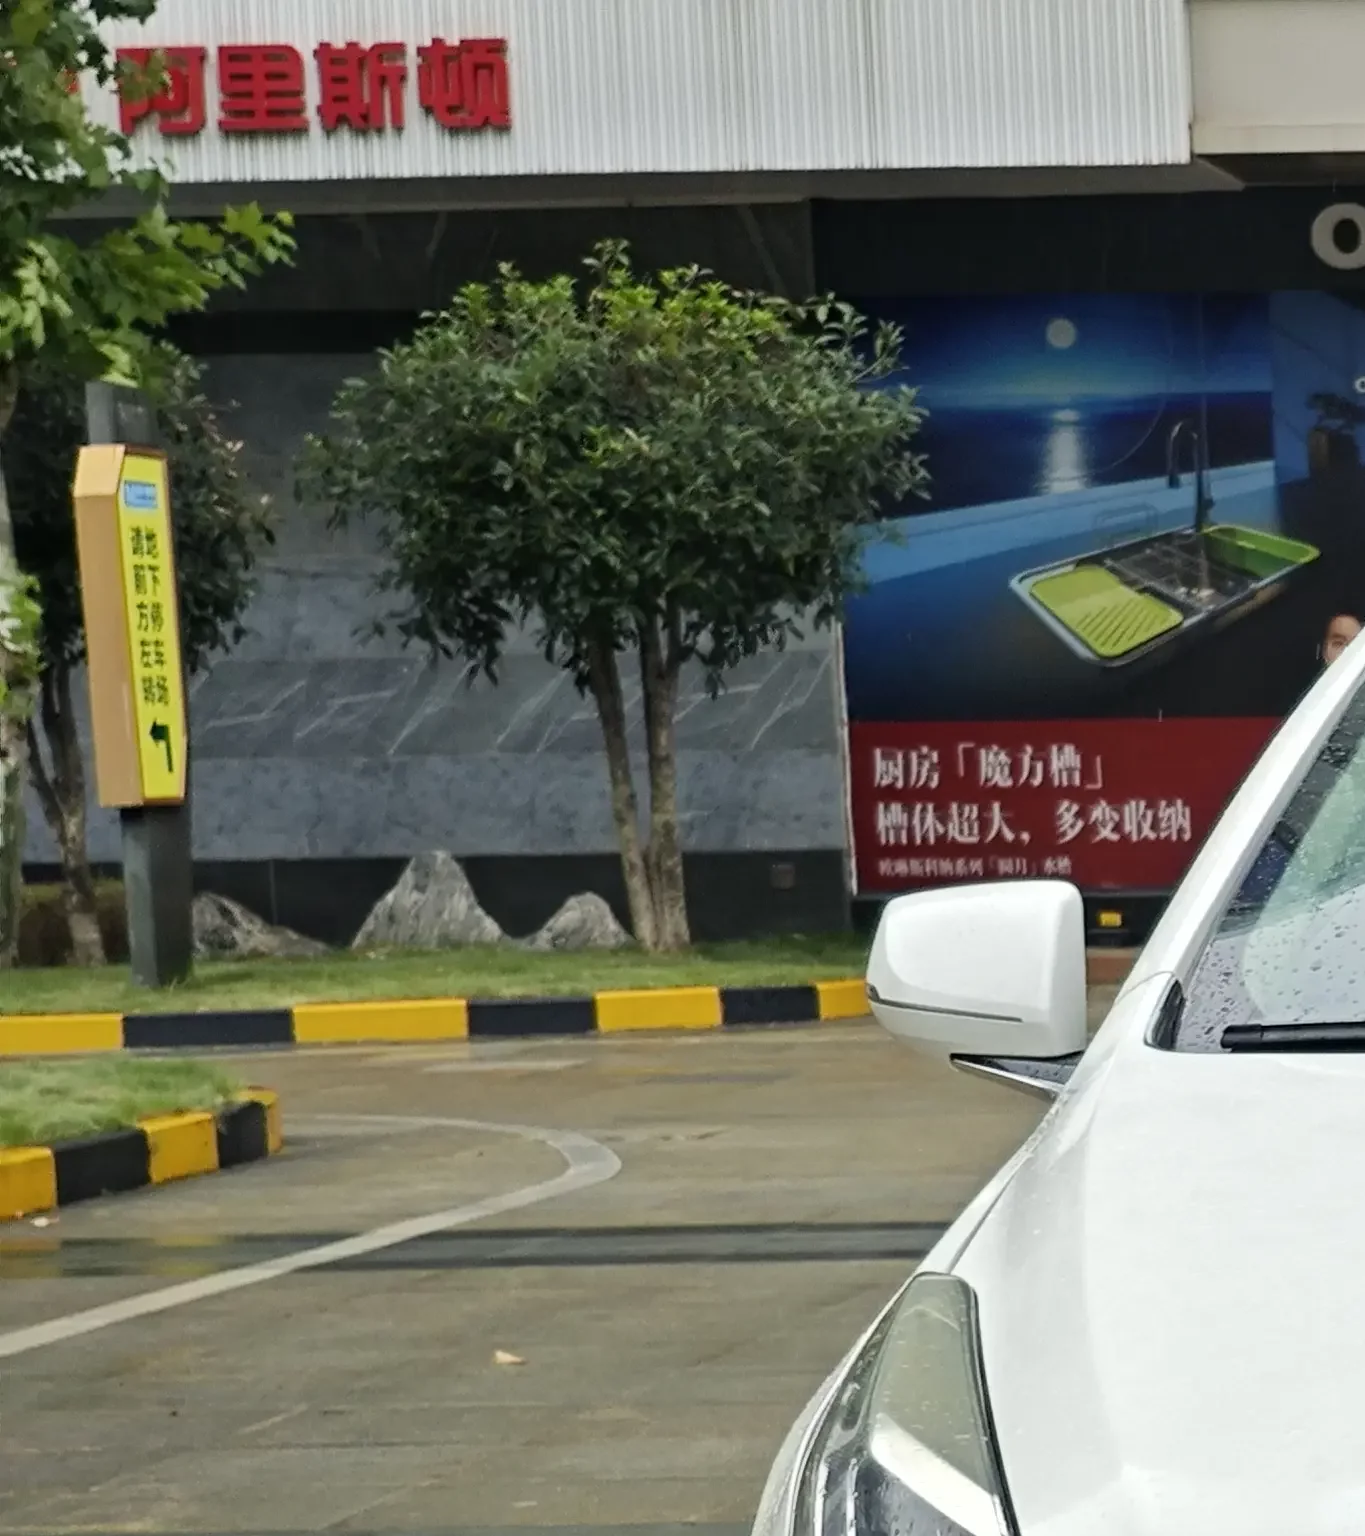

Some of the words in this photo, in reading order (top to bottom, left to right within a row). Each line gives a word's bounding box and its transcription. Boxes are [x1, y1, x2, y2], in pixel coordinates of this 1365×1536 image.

[116, 38, 511, 134] 阿里斯顿
[874, 742, 1103, 790] 厨房「魔方槽」
